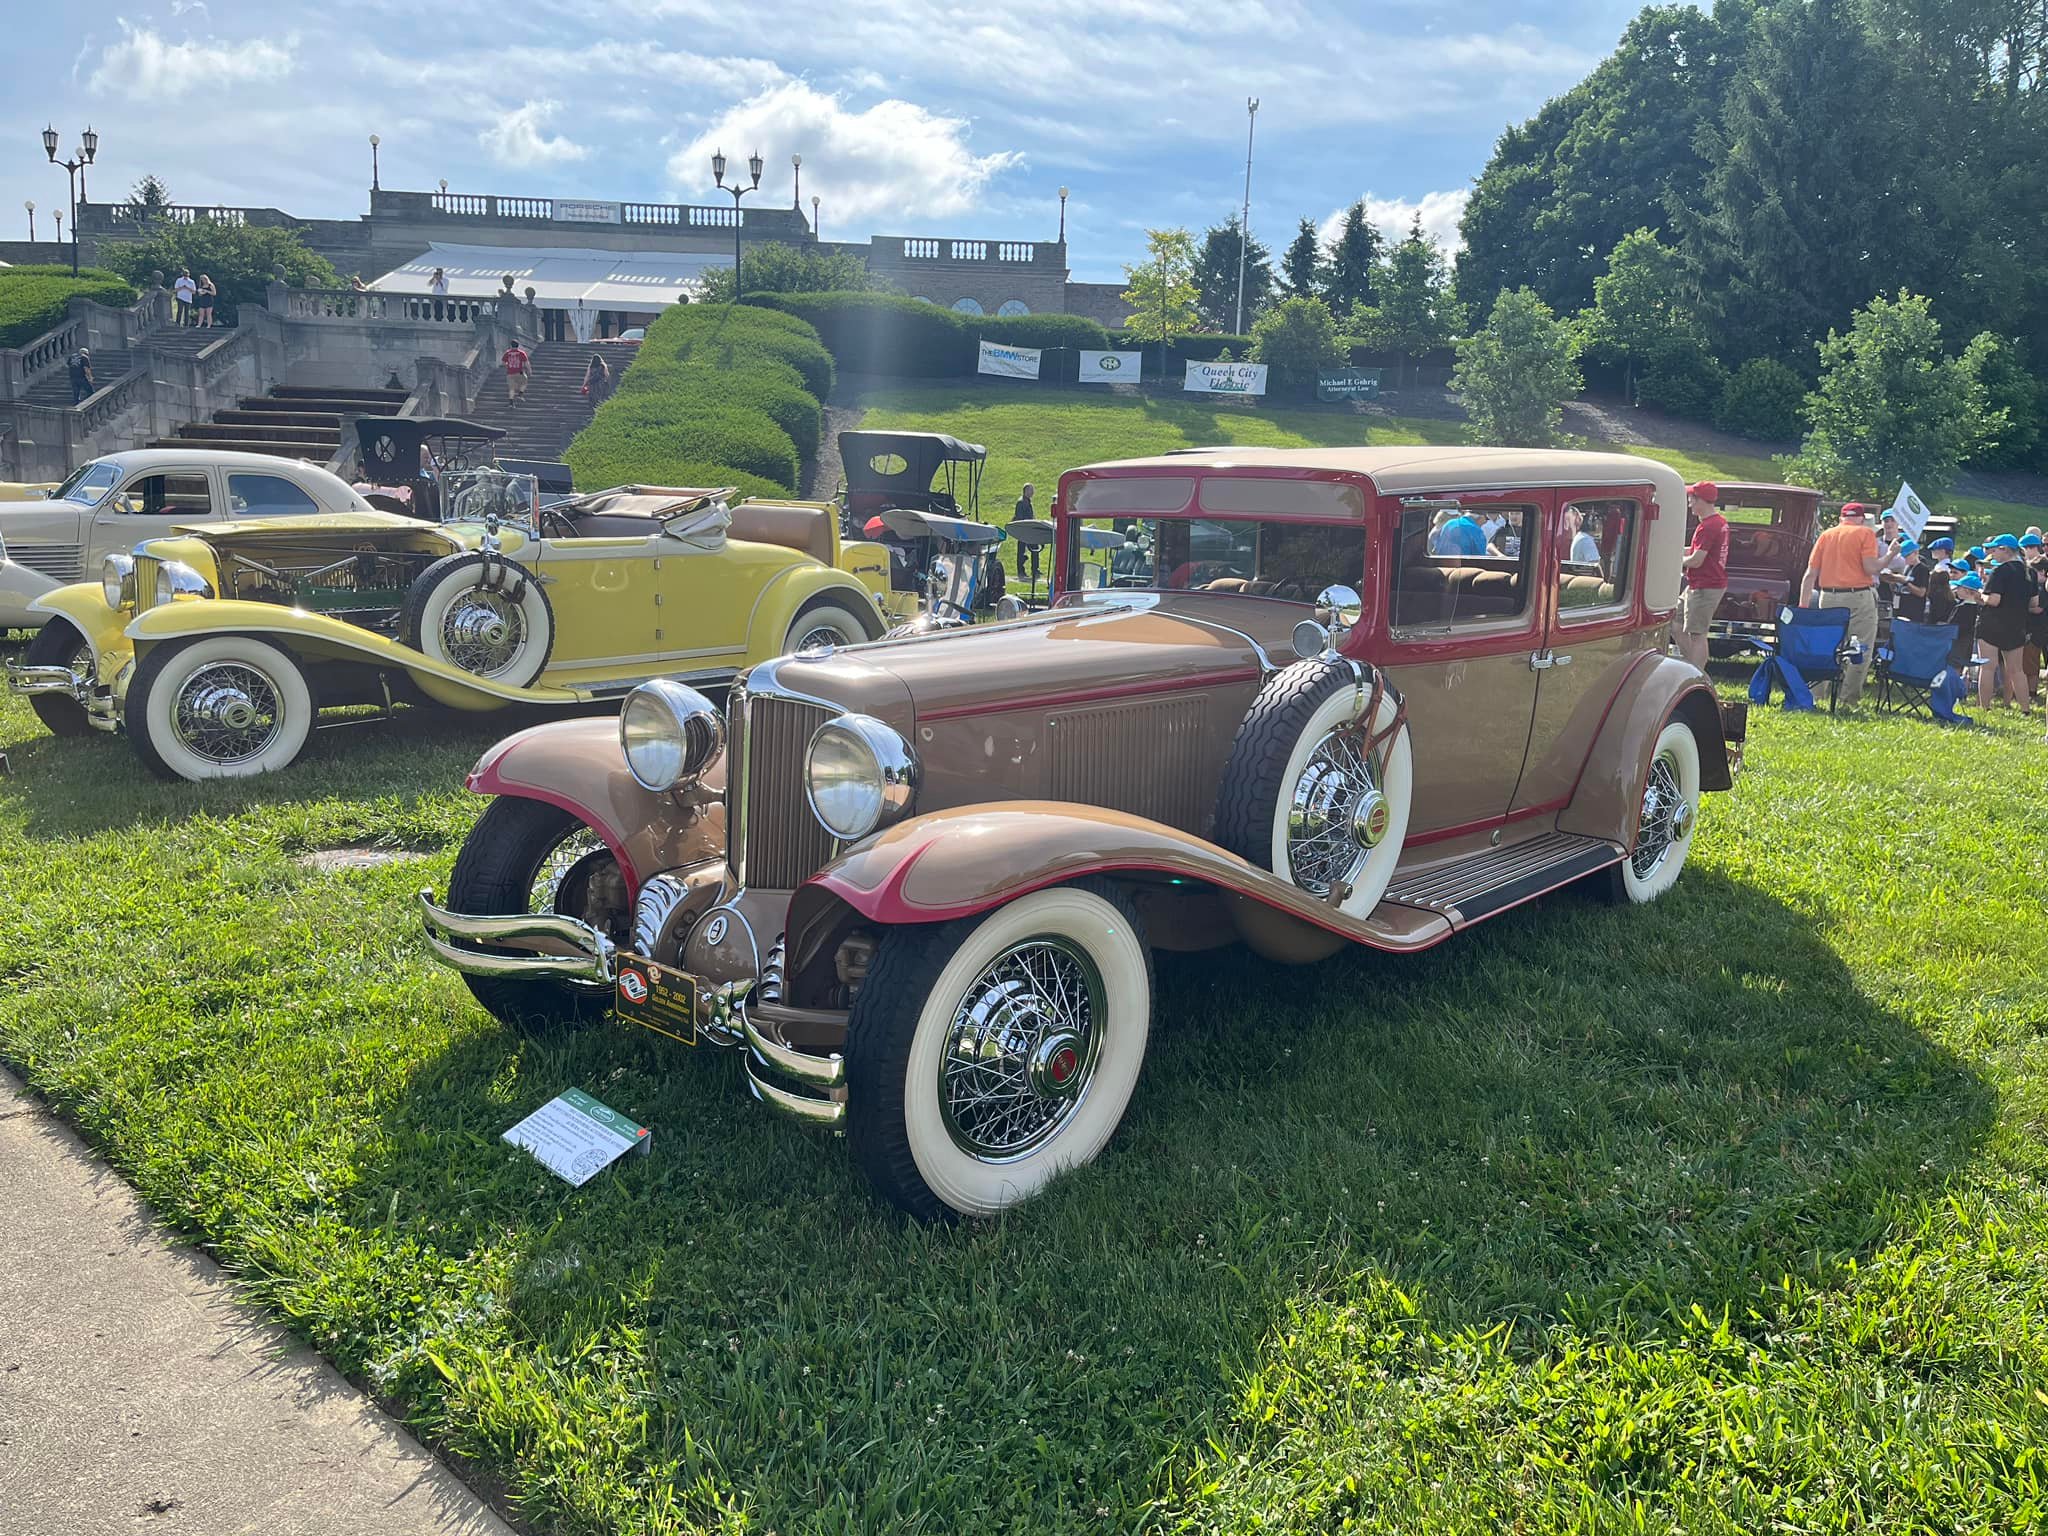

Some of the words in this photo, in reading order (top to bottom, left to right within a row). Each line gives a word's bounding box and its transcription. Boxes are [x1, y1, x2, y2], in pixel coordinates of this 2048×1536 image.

[1202, 365, 1235, 377] Queen
[1238, 367, 1258, 380] City
[1320, 378, 1346, 386] Michael
